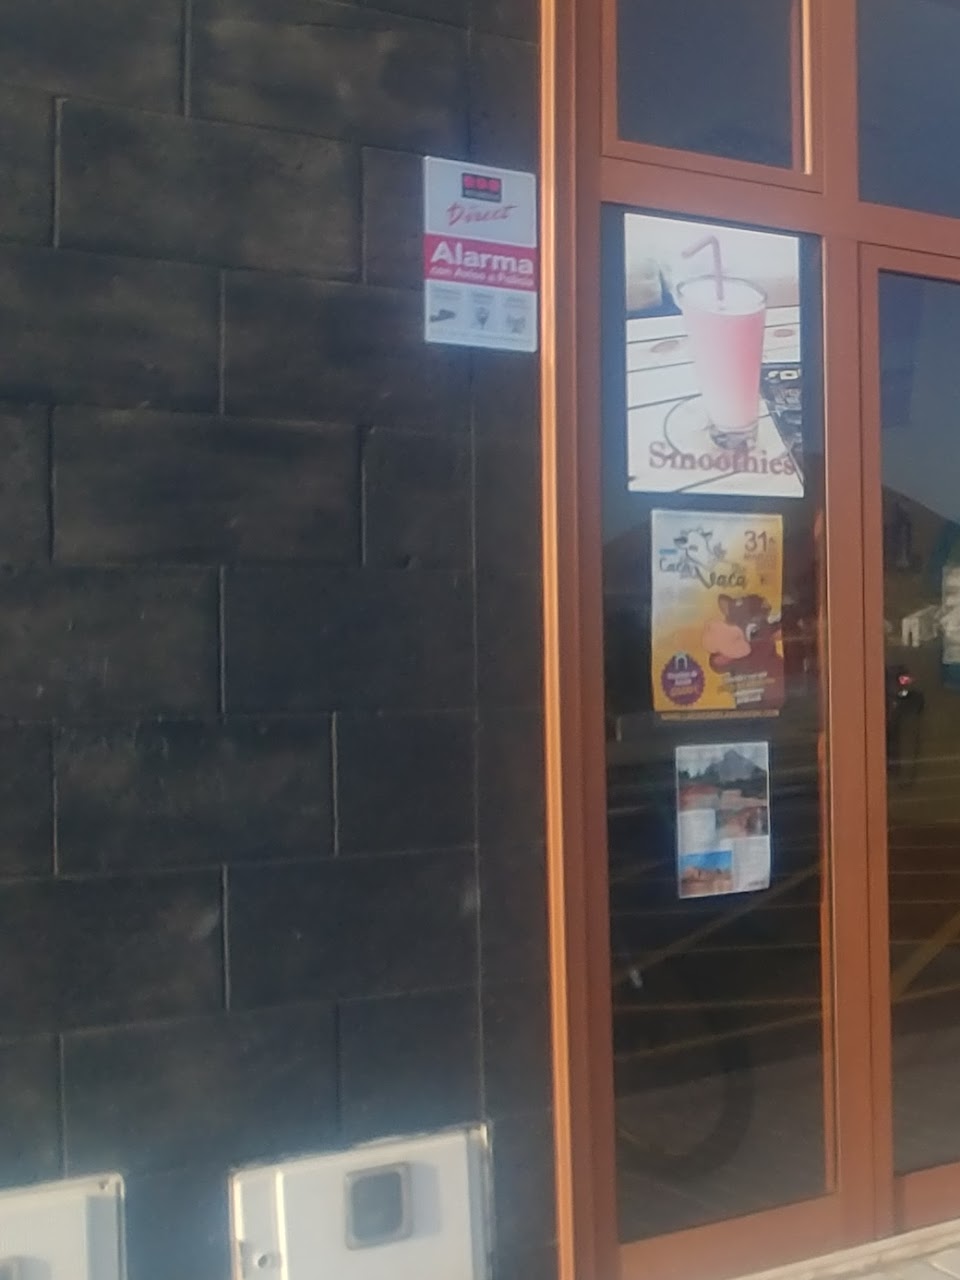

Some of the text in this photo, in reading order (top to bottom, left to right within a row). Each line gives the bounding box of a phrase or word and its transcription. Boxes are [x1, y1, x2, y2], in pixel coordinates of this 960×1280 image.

[430, 241, 535, 275] Alarma
[648, 441, 796, 475] Smoothies
[744, 530, 767, 552] 31
